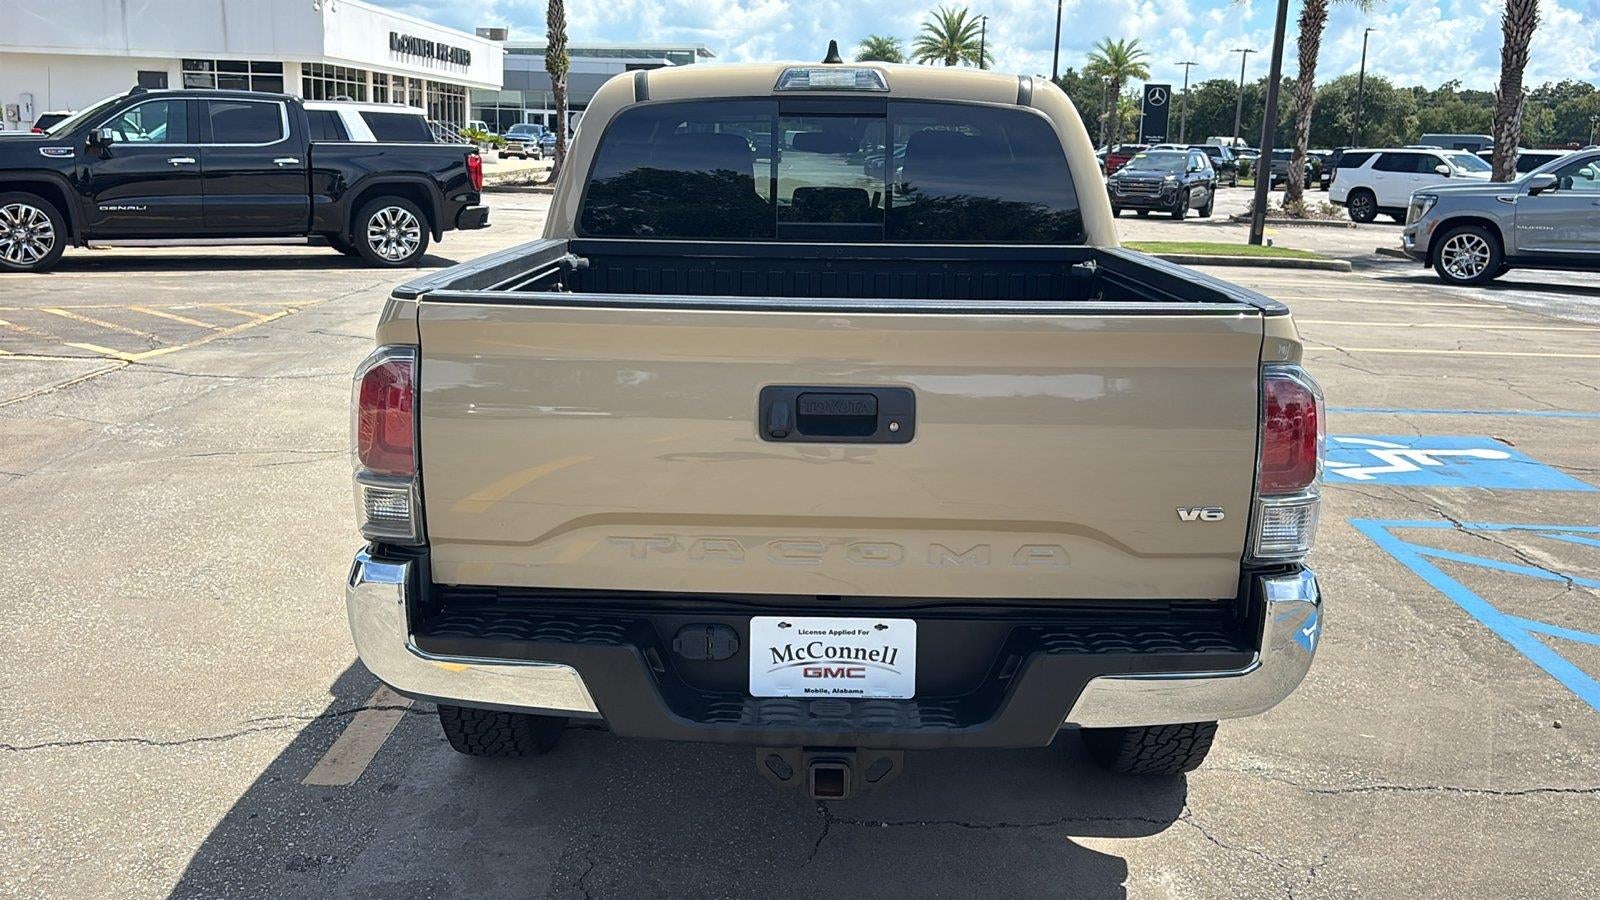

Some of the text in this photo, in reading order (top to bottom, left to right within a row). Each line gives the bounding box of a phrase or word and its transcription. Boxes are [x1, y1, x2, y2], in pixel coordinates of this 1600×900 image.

[806, 399, 871, 414] TOYOTA
[1176, 506, 1225, 521] V6
[607, 536, 1072, 567] TACOMA
[828, 629, 856, 637] Applied
[769, 641, 899, 667] McConnell
[803, 667, 866, 679] GMC
